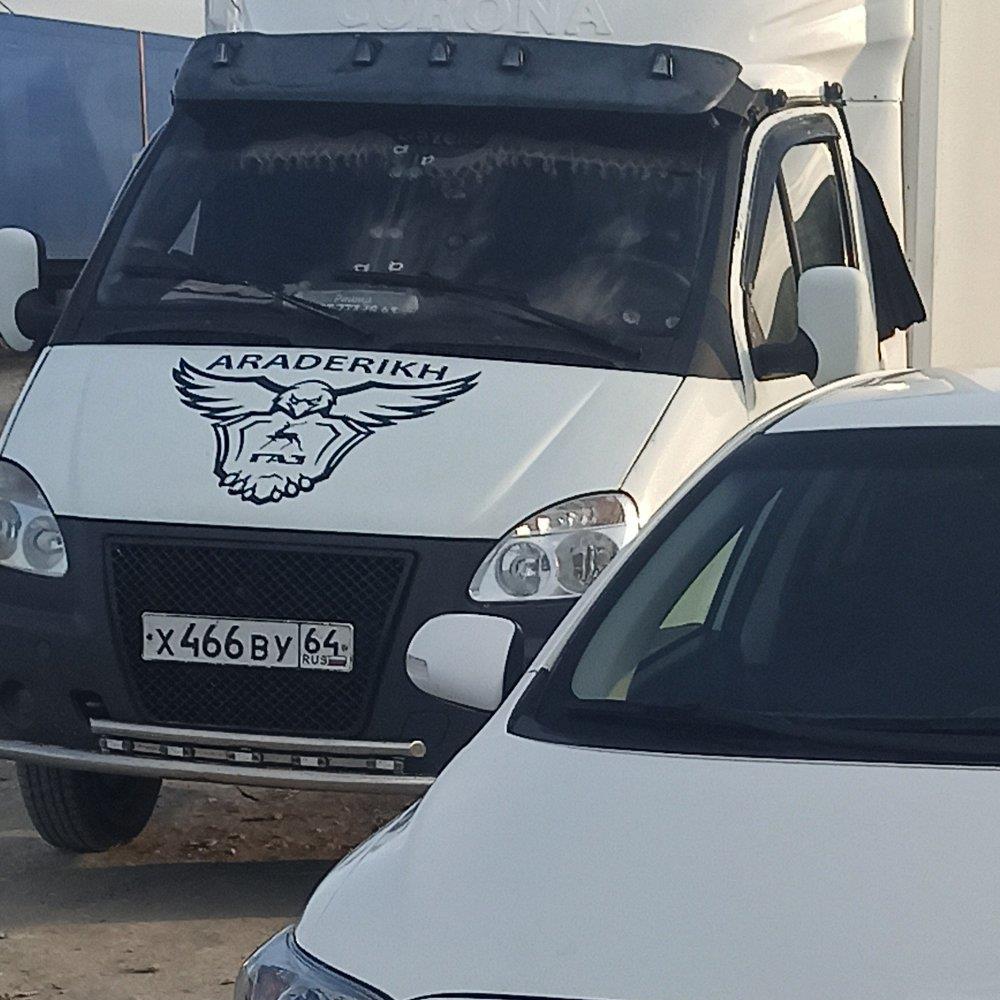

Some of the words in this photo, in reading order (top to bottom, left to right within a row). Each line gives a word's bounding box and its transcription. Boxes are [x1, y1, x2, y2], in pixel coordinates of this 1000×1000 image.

[206, 354, 449, 380] ARADERIKH
[304, 627, 339, 657] 64
[302, 655, 328, 665] RUS
